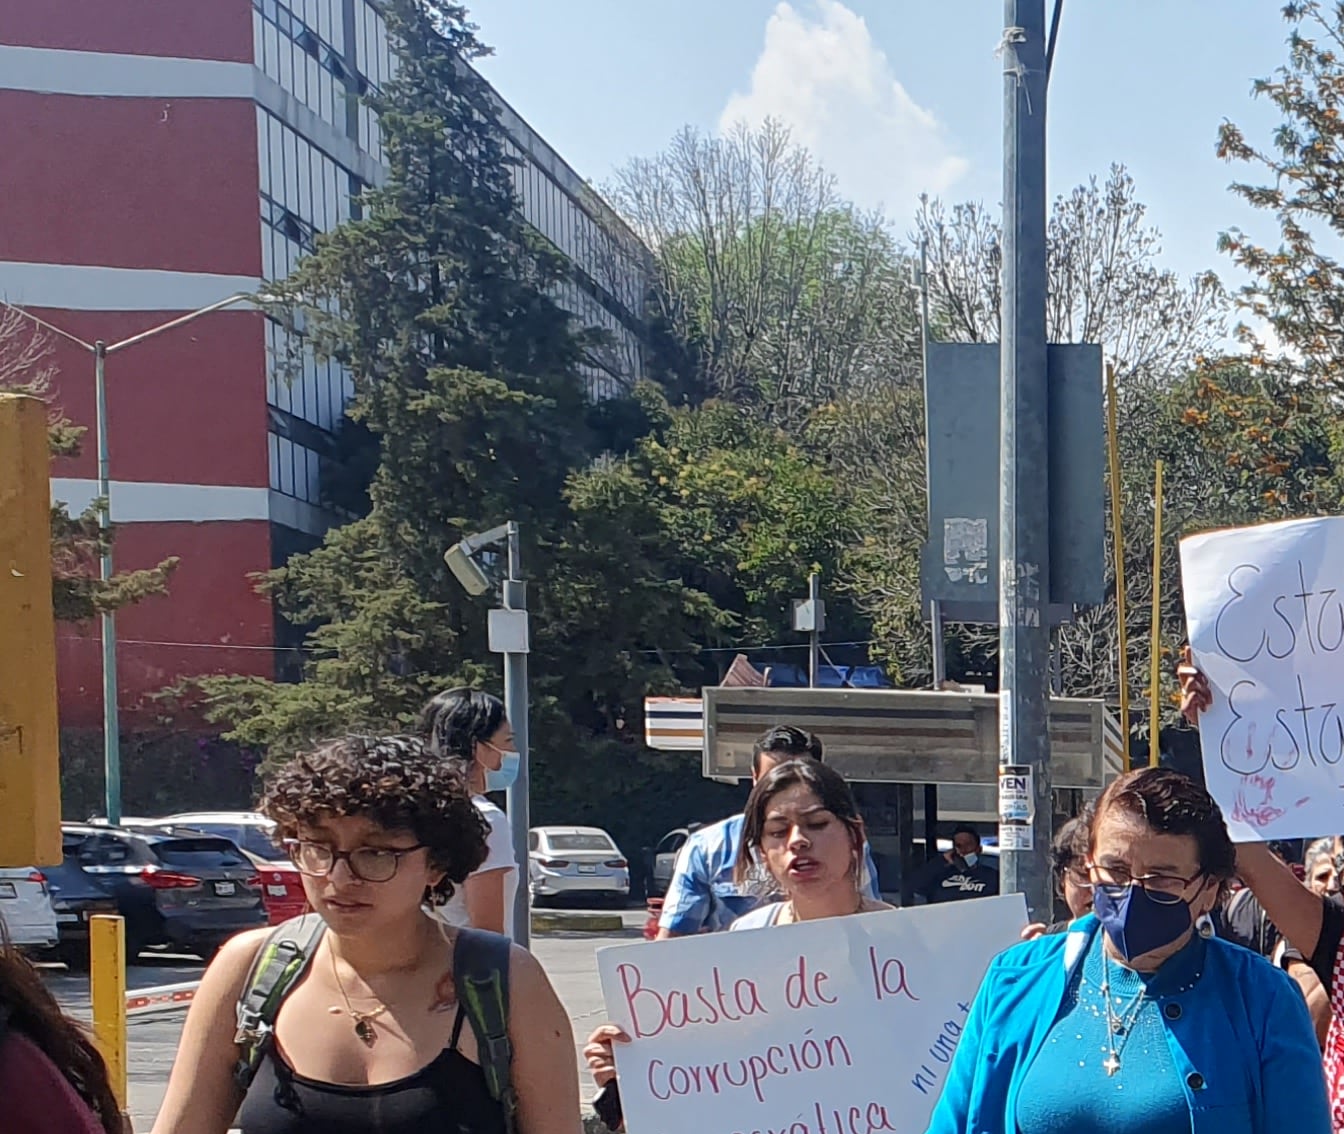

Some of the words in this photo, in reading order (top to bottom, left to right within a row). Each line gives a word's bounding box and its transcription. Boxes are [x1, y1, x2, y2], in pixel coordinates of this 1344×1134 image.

[616, 963, 768, 1038] Basta
[785, 956, 838, 1009] de
[868, 946, 920, 1001] la
